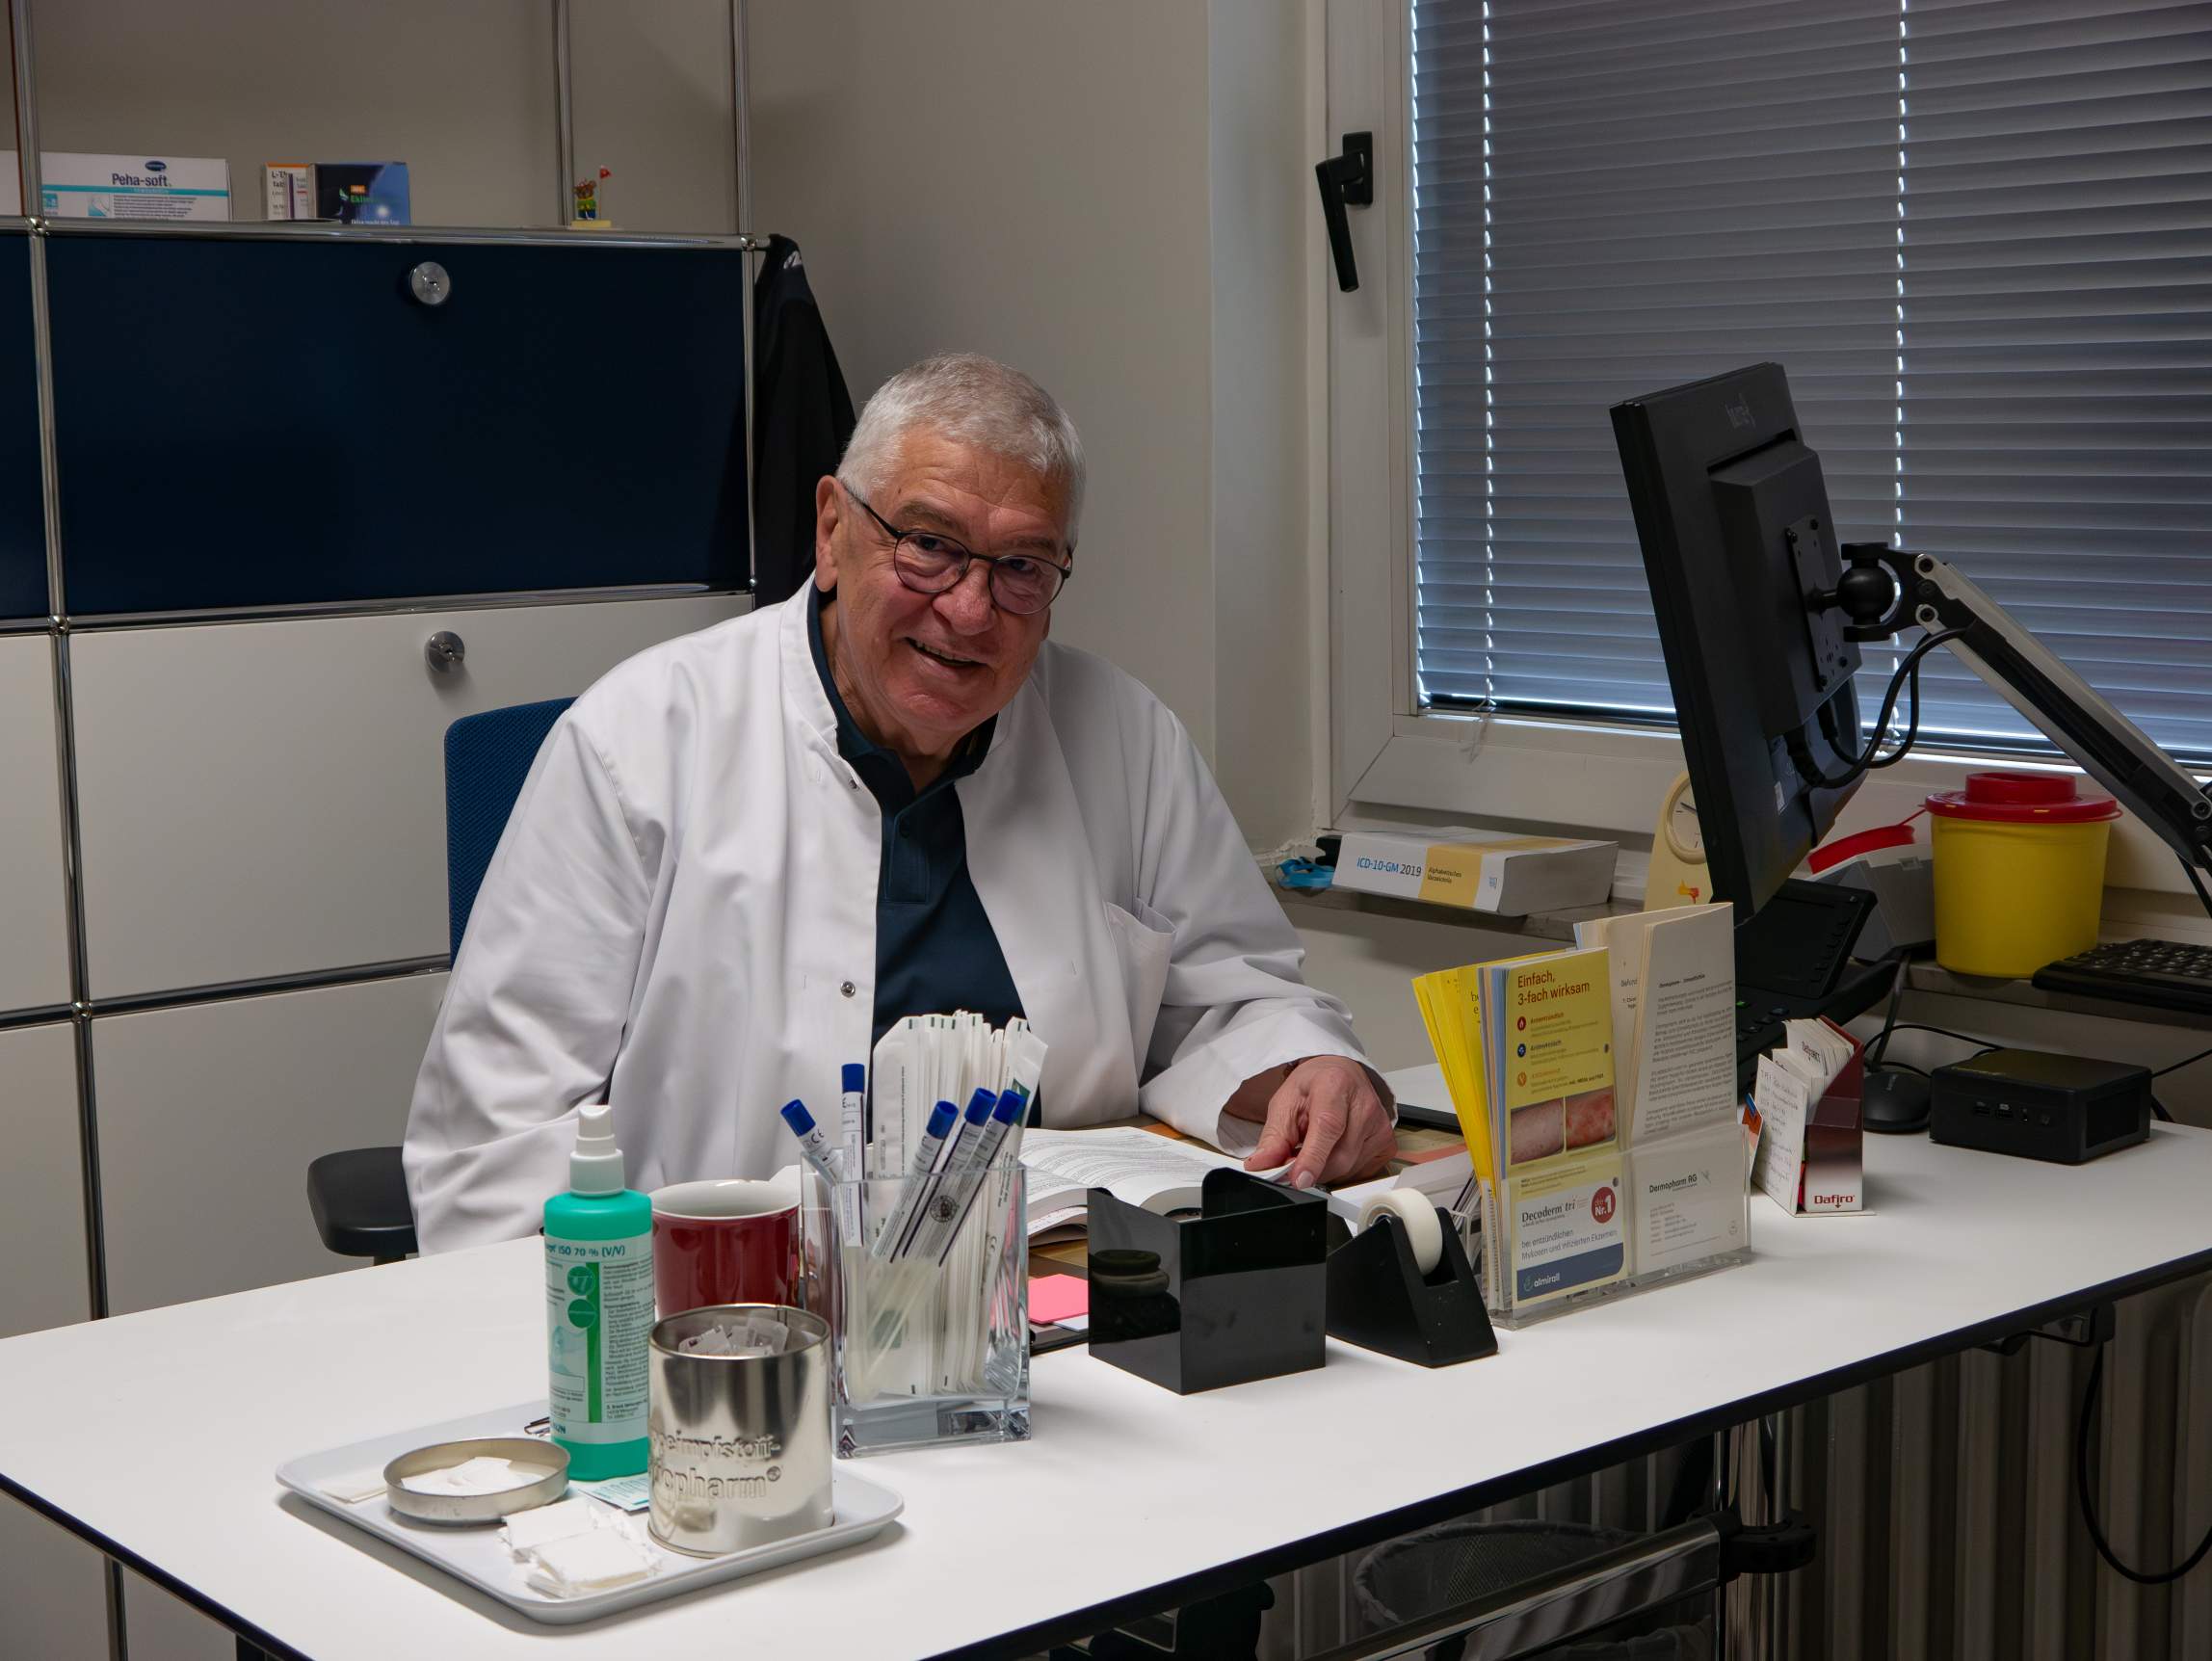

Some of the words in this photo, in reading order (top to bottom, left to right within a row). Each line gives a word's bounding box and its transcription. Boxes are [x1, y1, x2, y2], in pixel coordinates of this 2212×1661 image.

[112, 173, 168, 187] Peha-soft
[1400, 863, 1422, 877] 2019
[1517, 969, 1555, 989] Einfach,
[1517, 988, 1548, 1006] 3-fach
[1550, 982, 1590, 999] wirksam
[1521, 1204, 1563, 1223] Decoderm
[1565, 1199, 1576, 1212] tri
